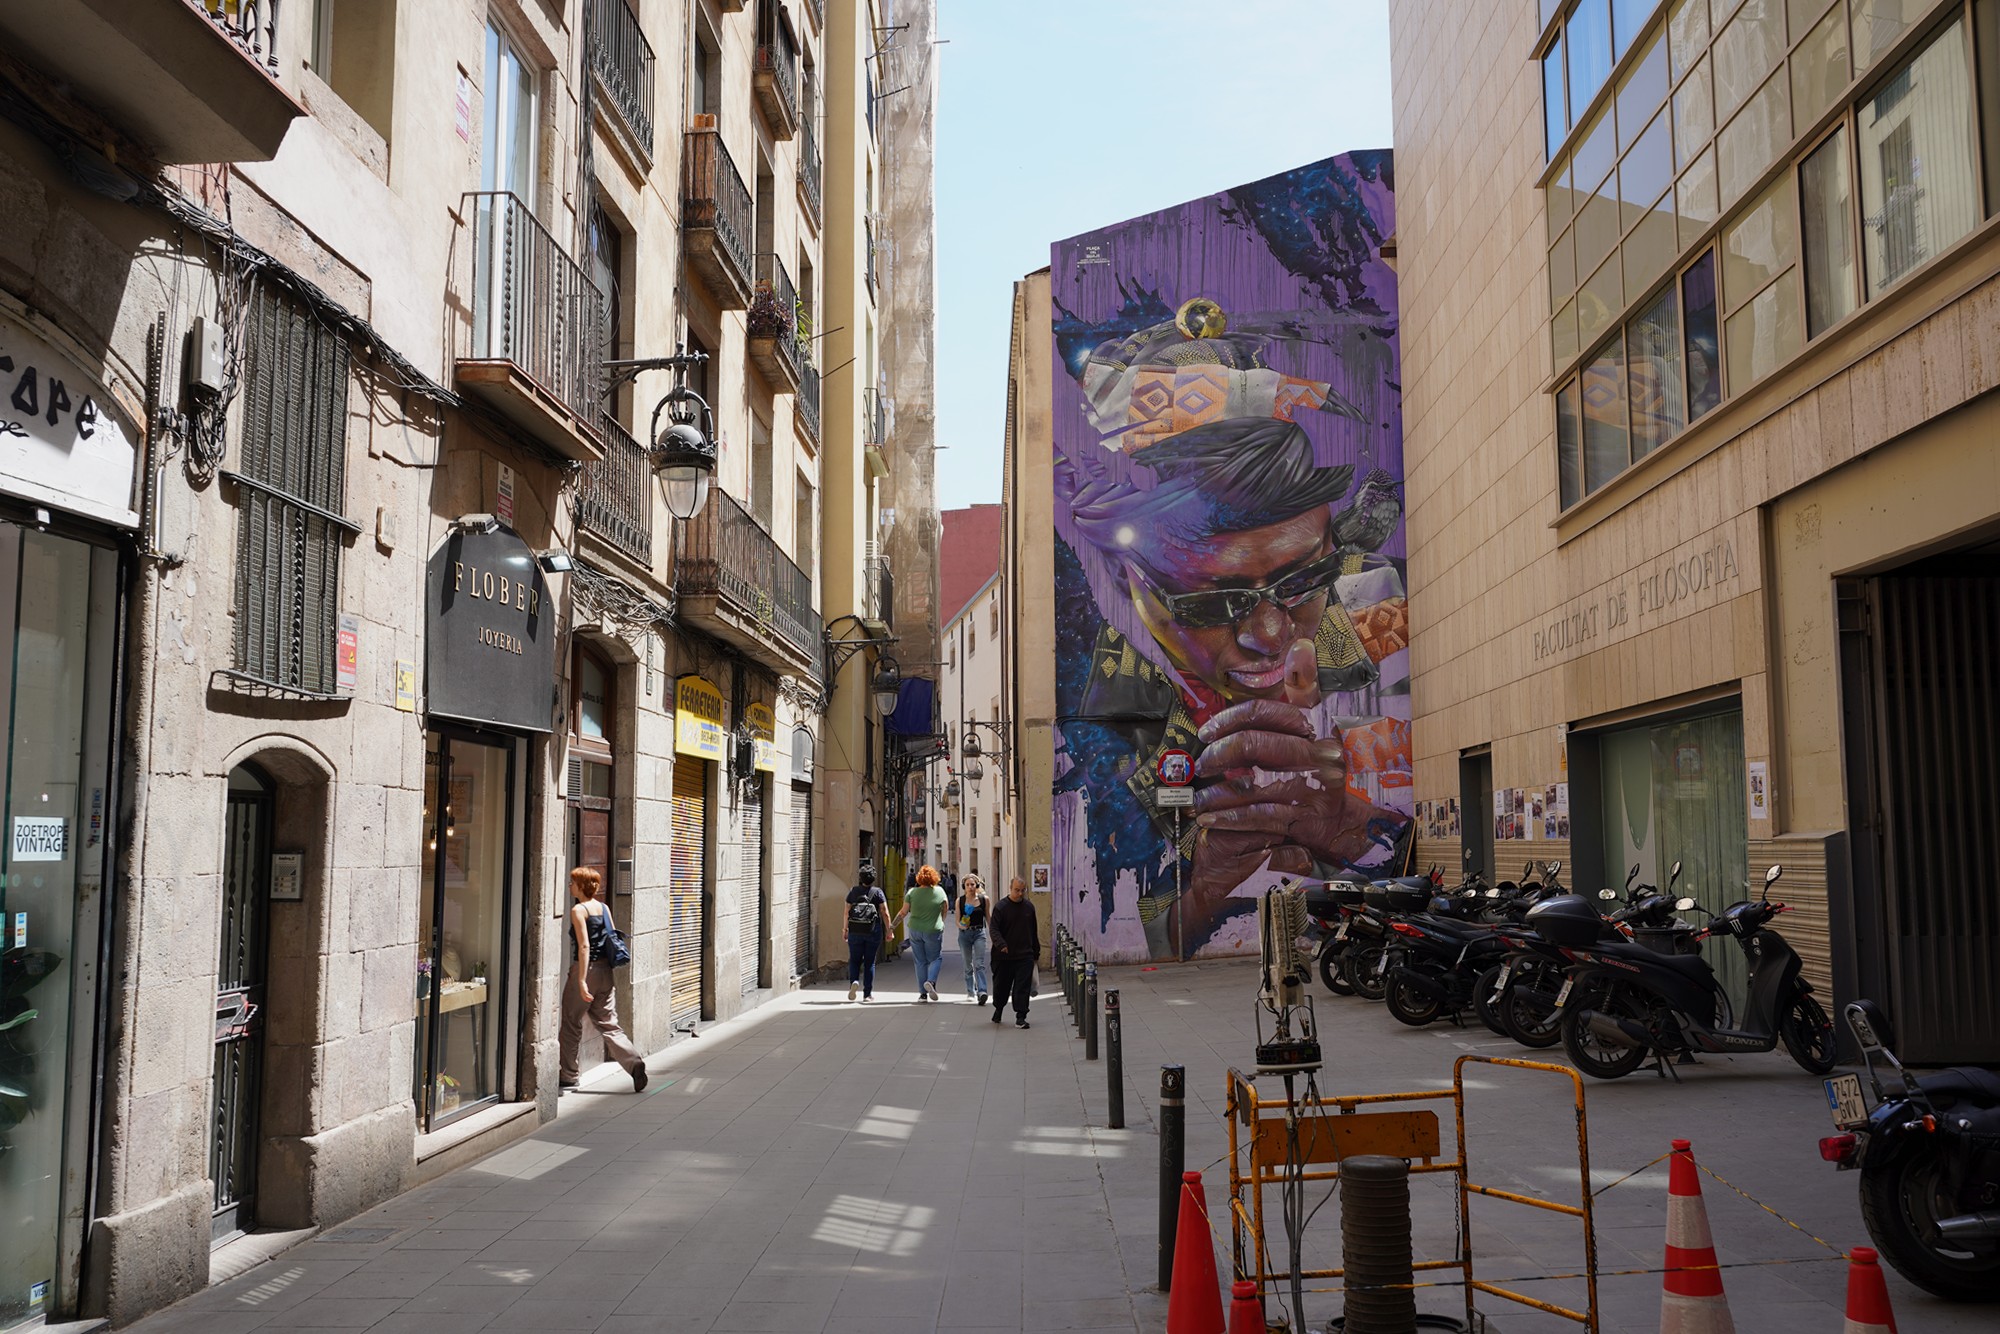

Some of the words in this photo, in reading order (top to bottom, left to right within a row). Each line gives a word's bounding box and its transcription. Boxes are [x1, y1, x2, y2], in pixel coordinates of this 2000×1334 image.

[455, 561, 539, 616] FLOBER
[1534, 604, 1599, 661] FACULTAT
[1607, 590, 1629, 630] DE
[1638, 540, 1739, 617] FILOSOFIA
[479, 627, 522, 655] JOYERIA
[681, 684, 721, 721] FERRETERIA
[16, 825, 69, 838] ZOETROPE
[16, 837, 68, 852] VINTAGE
[1725, 1035, 1765, 1046] HONDA
[1833, 1079, 1859, 1100] 7472
[34, 1285, 48, 1298] VISA
